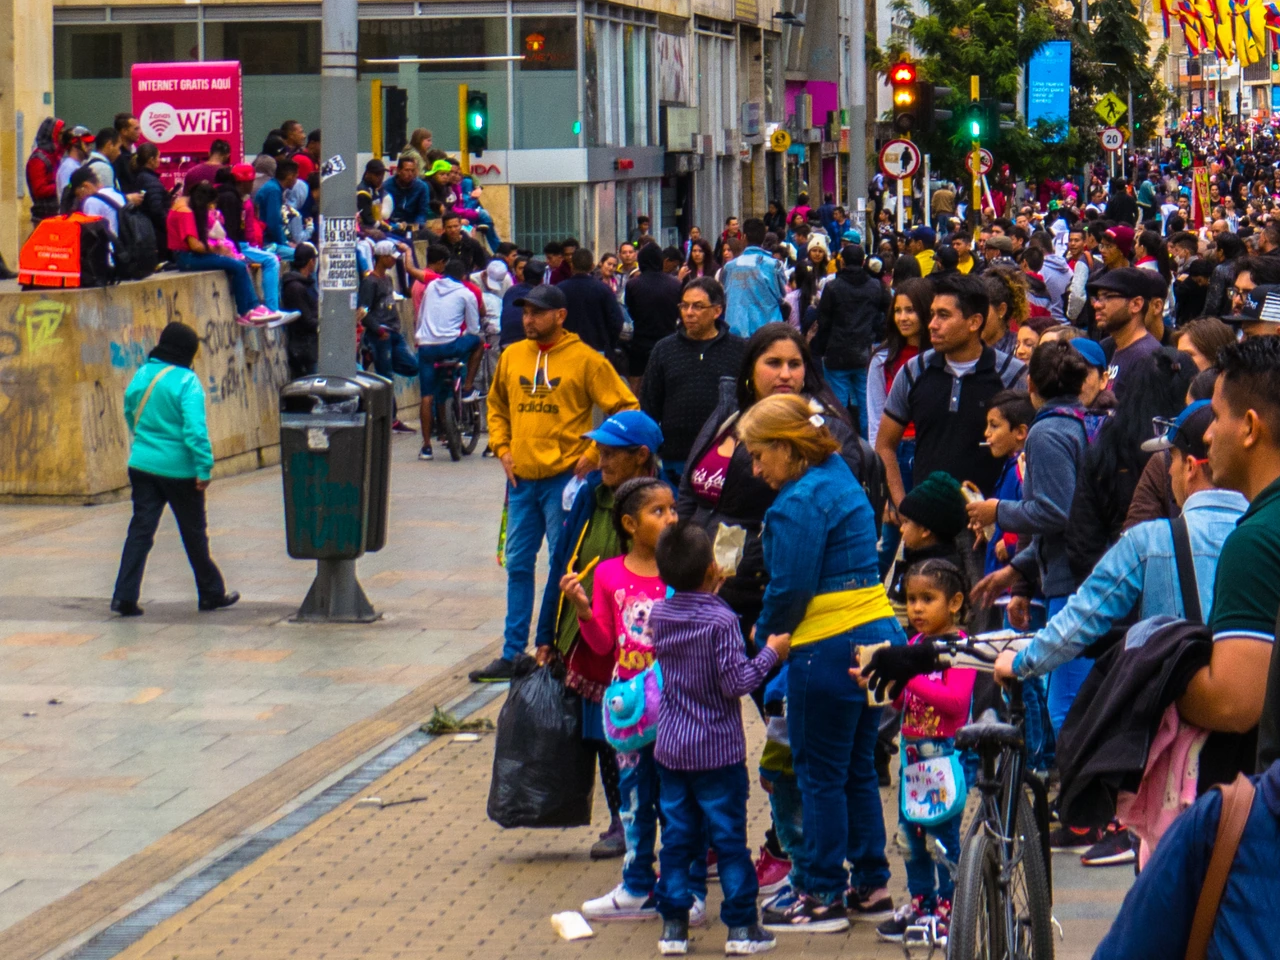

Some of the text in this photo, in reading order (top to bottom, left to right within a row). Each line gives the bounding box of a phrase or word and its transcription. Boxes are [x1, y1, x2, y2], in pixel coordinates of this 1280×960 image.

[138, 76, 232, 91] INTERNET GRATIS AQUÍ
[149, 111, 171, 119] Zonas
[177, 110, 228, 132] WiFi
[1106, 134, 1118, 144] 20
[517, 400, 559, 414] adidas
